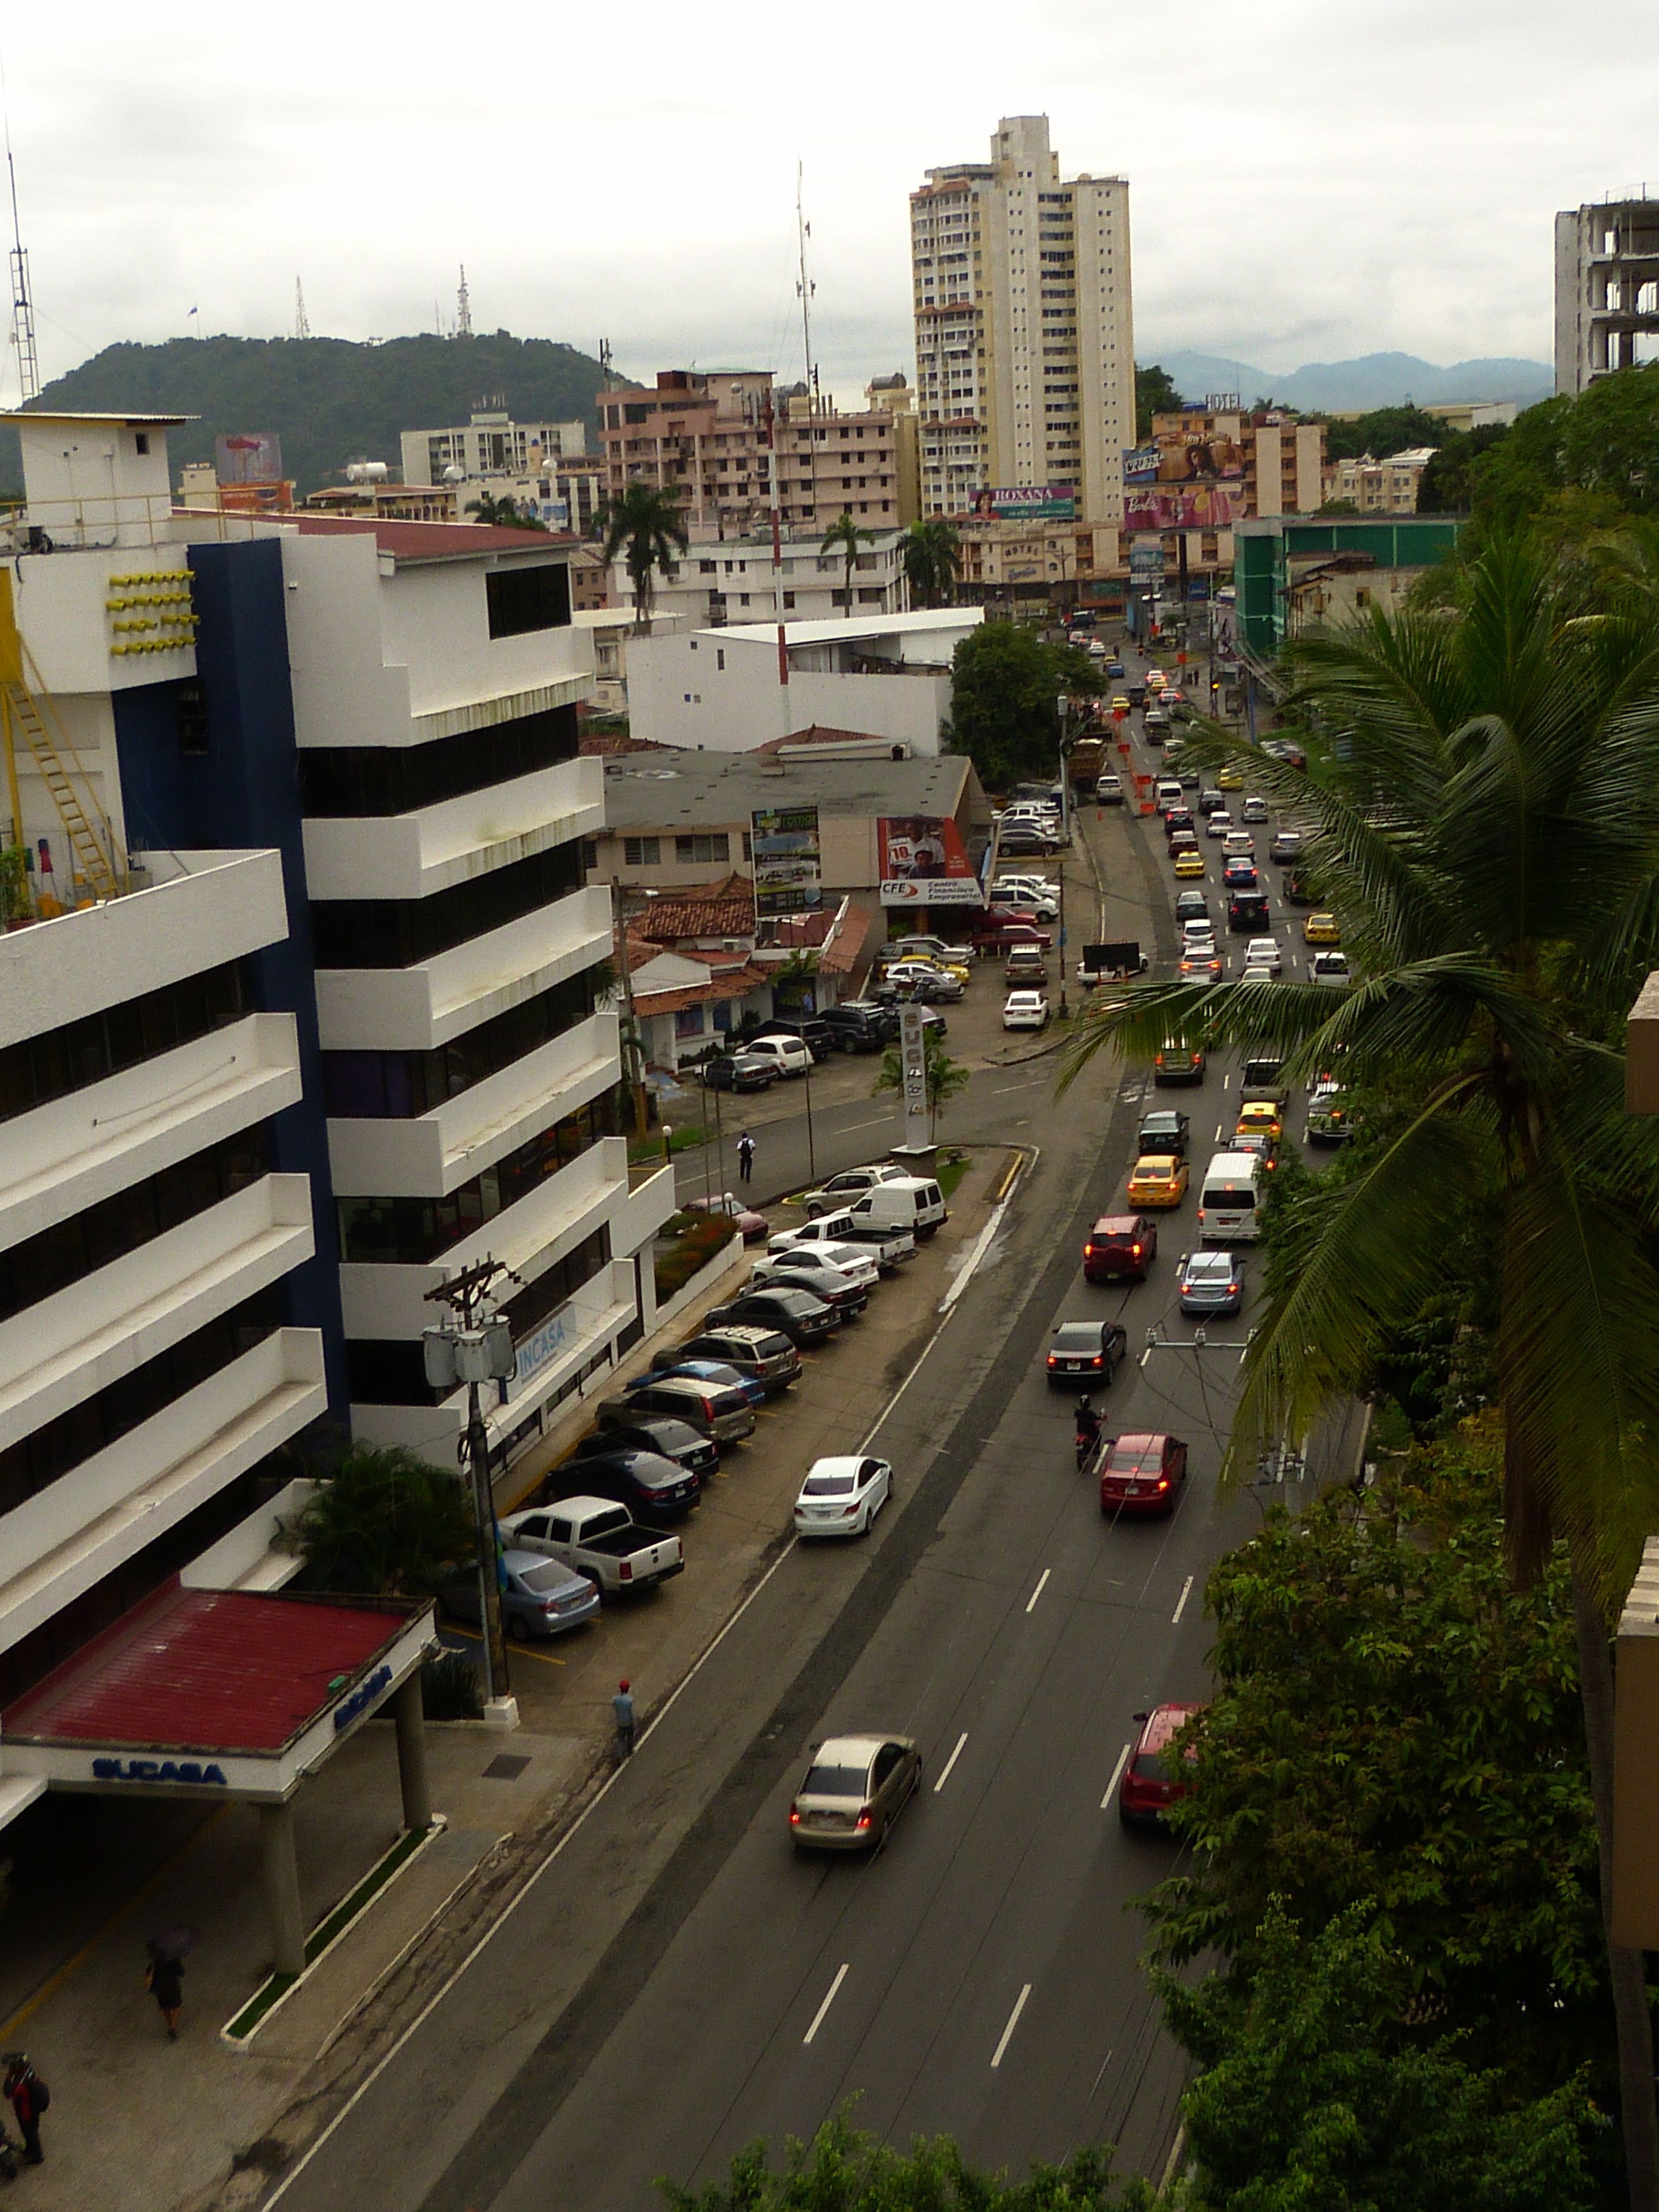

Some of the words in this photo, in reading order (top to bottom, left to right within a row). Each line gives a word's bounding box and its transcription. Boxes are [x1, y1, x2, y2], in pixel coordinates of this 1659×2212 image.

[1206, 393, 1242, 411] HOTEL
[995, 489, 1053, 501] ROXANA
[1128, 497, 1159, 513] Barbie
[882, 883, 906, 893] CFE
[92, 1758, 227, 1785] SUCASA
